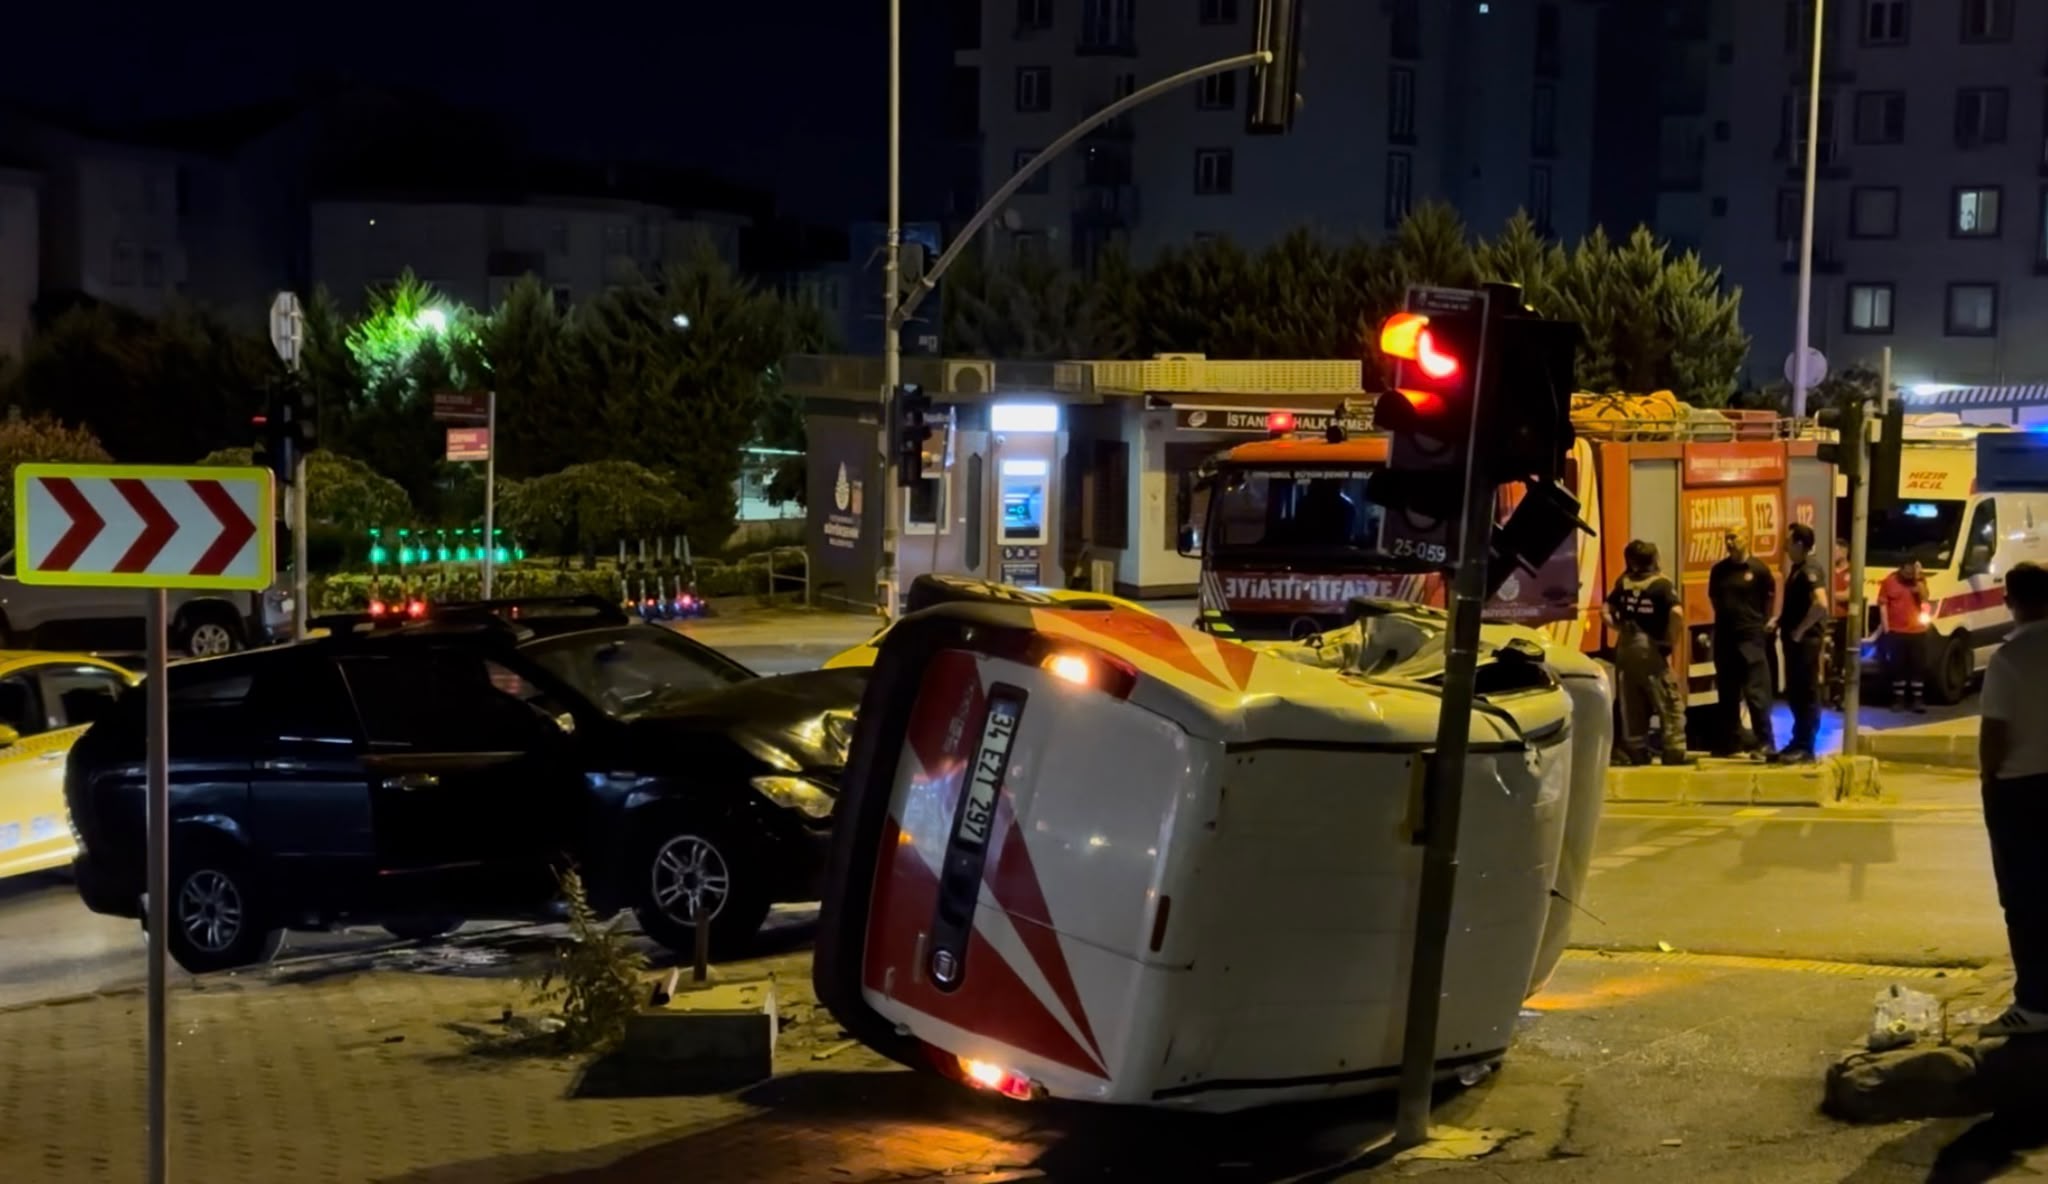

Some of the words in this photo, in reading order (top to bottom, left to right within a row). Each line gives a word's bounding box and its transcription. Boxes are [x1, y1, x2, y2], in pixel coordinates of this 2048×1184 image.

[1293, 416, 1327, 429] HALK
[1755, 502, 1774, 529] 112
[1394, 538, 1446, 562] 25-059
[988, 714, 1013, 739] 34
[976, 748, 1002, 789] EZT
[964, 798, 991, 838] 297
